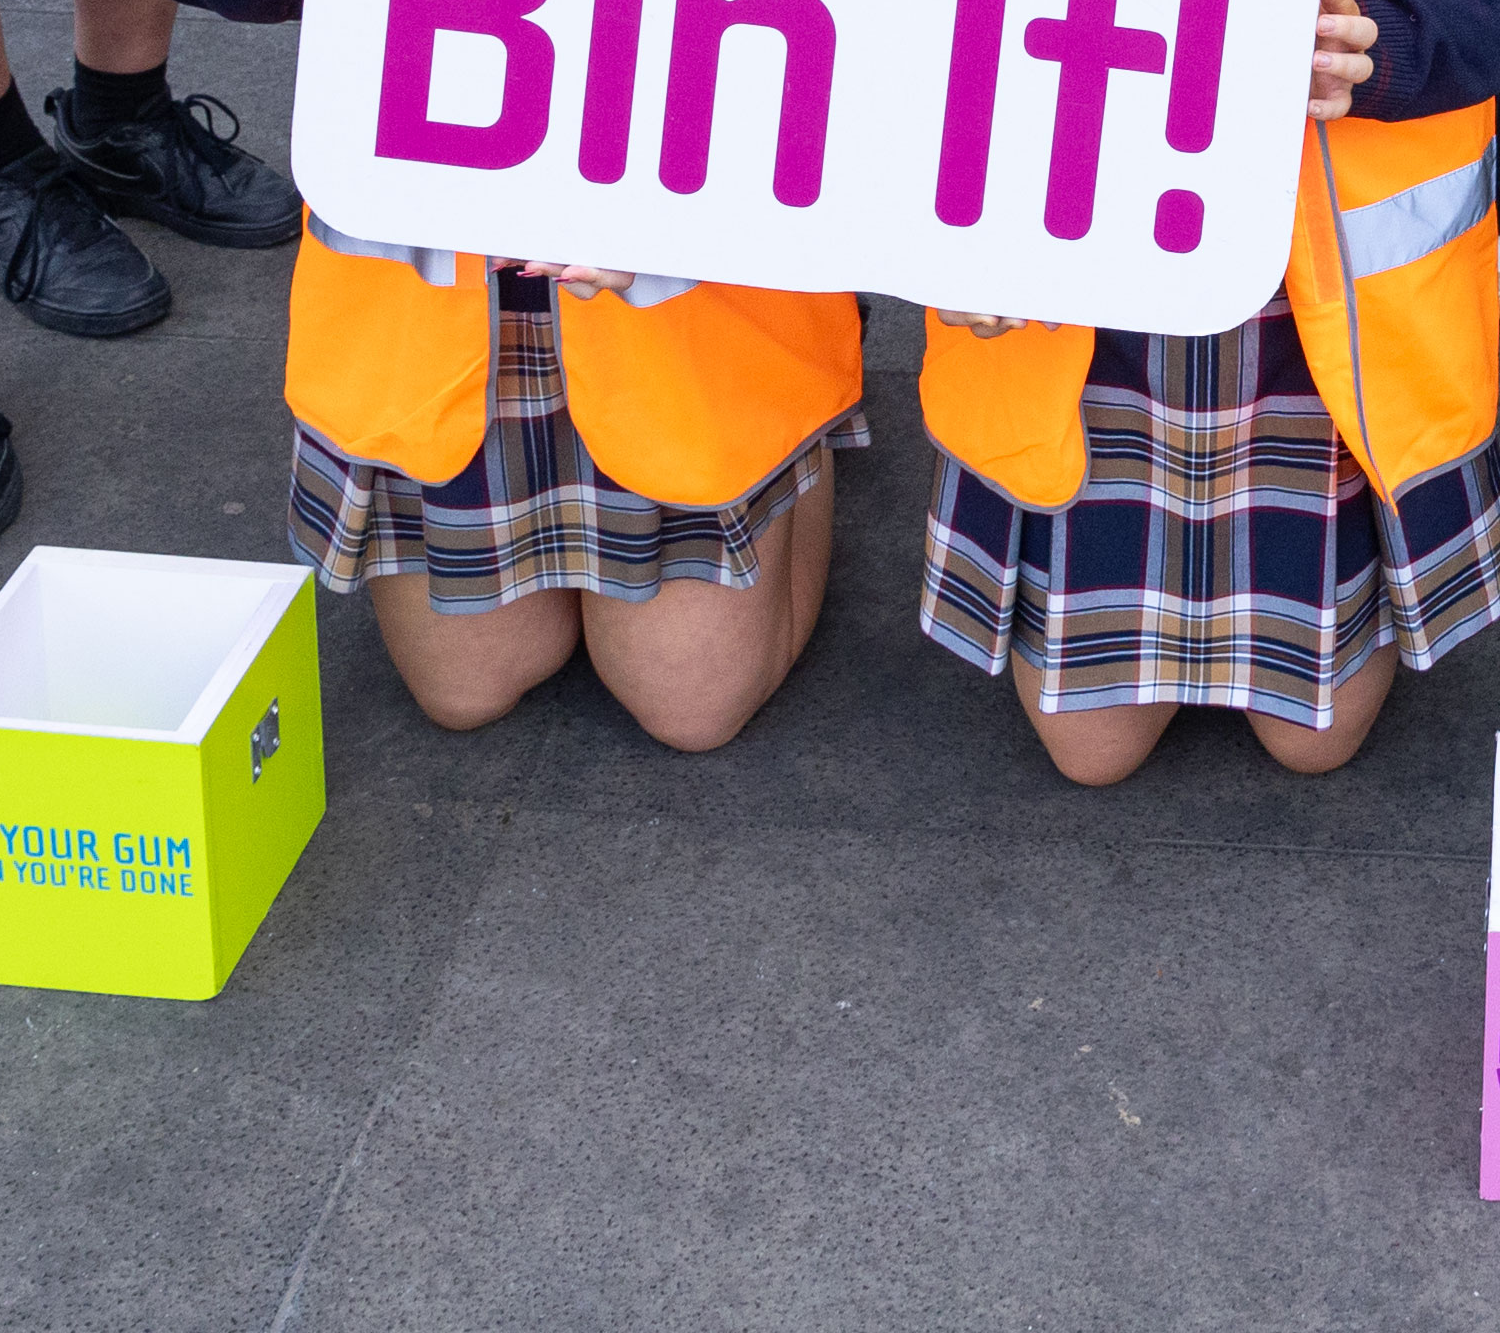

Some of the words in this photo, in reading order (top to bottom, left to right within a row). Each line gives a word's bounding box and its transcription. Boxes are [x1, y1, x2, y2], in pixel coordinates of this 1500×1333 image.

[113, 833, 191, 868] GUM
[14, 860, 110, 892] YOU'RE
[120, 869, 194, 897] DONE
